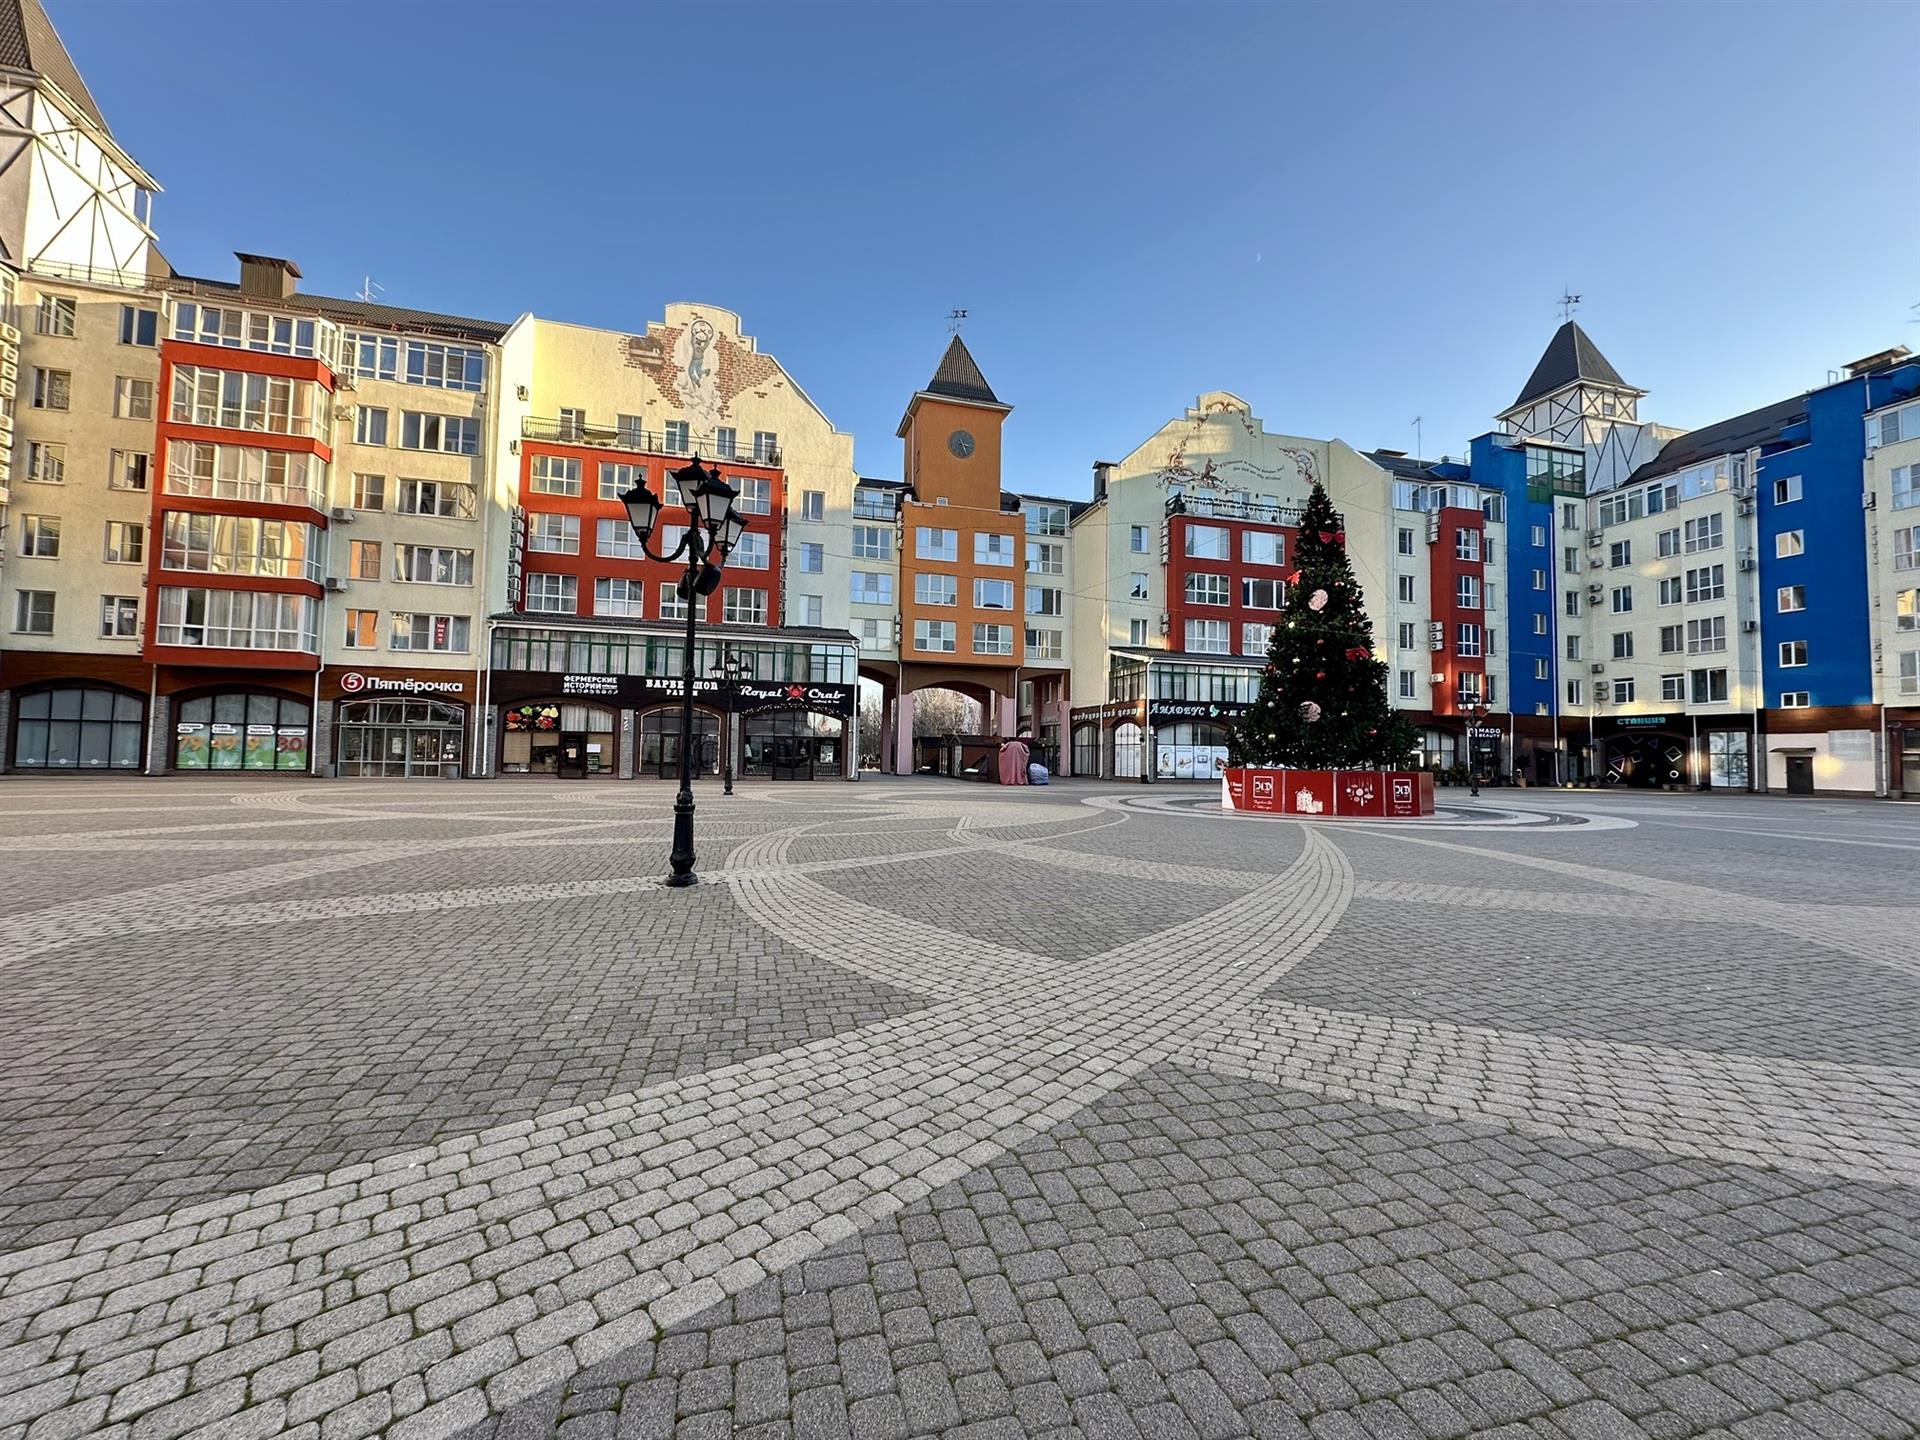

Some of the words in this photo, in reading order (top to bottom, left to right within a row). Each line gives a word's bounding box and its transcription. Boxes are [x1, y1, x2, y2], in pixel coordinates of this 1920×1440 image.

[367, 676, 463, 693] Пятёрочка
[563, 675, 618, 684] ФЕРМЕРСКИЕ
[645, 679, 718, 691] БАРБЕШОП
[739, 685, 783, 699] Royal
[808, 688, 846, 699] Crab
